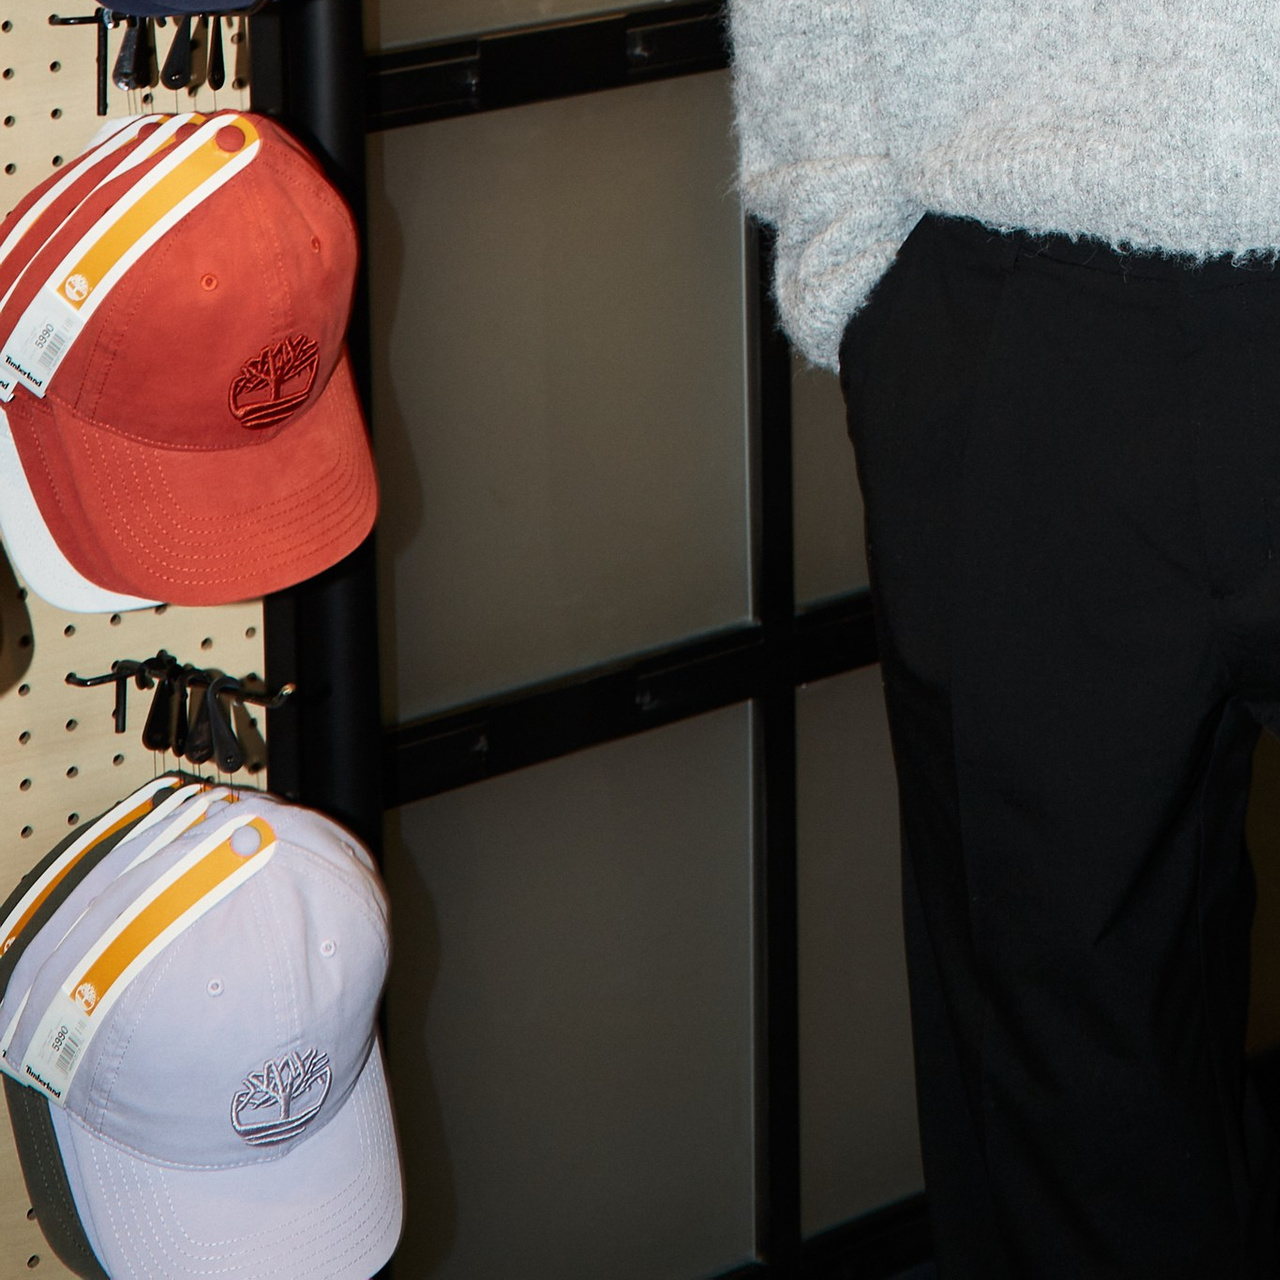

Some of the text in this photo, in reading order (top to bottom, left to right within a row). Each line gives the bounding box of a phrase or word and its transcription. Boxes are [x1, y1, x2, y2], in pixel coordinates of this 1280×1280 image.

[34, 323, 54, 349] 5990
[5, 354, 43, 388] Timberland
[51, 1025, 69, 1052] 5990
[25, 1064, 62, 1099] Timberland
